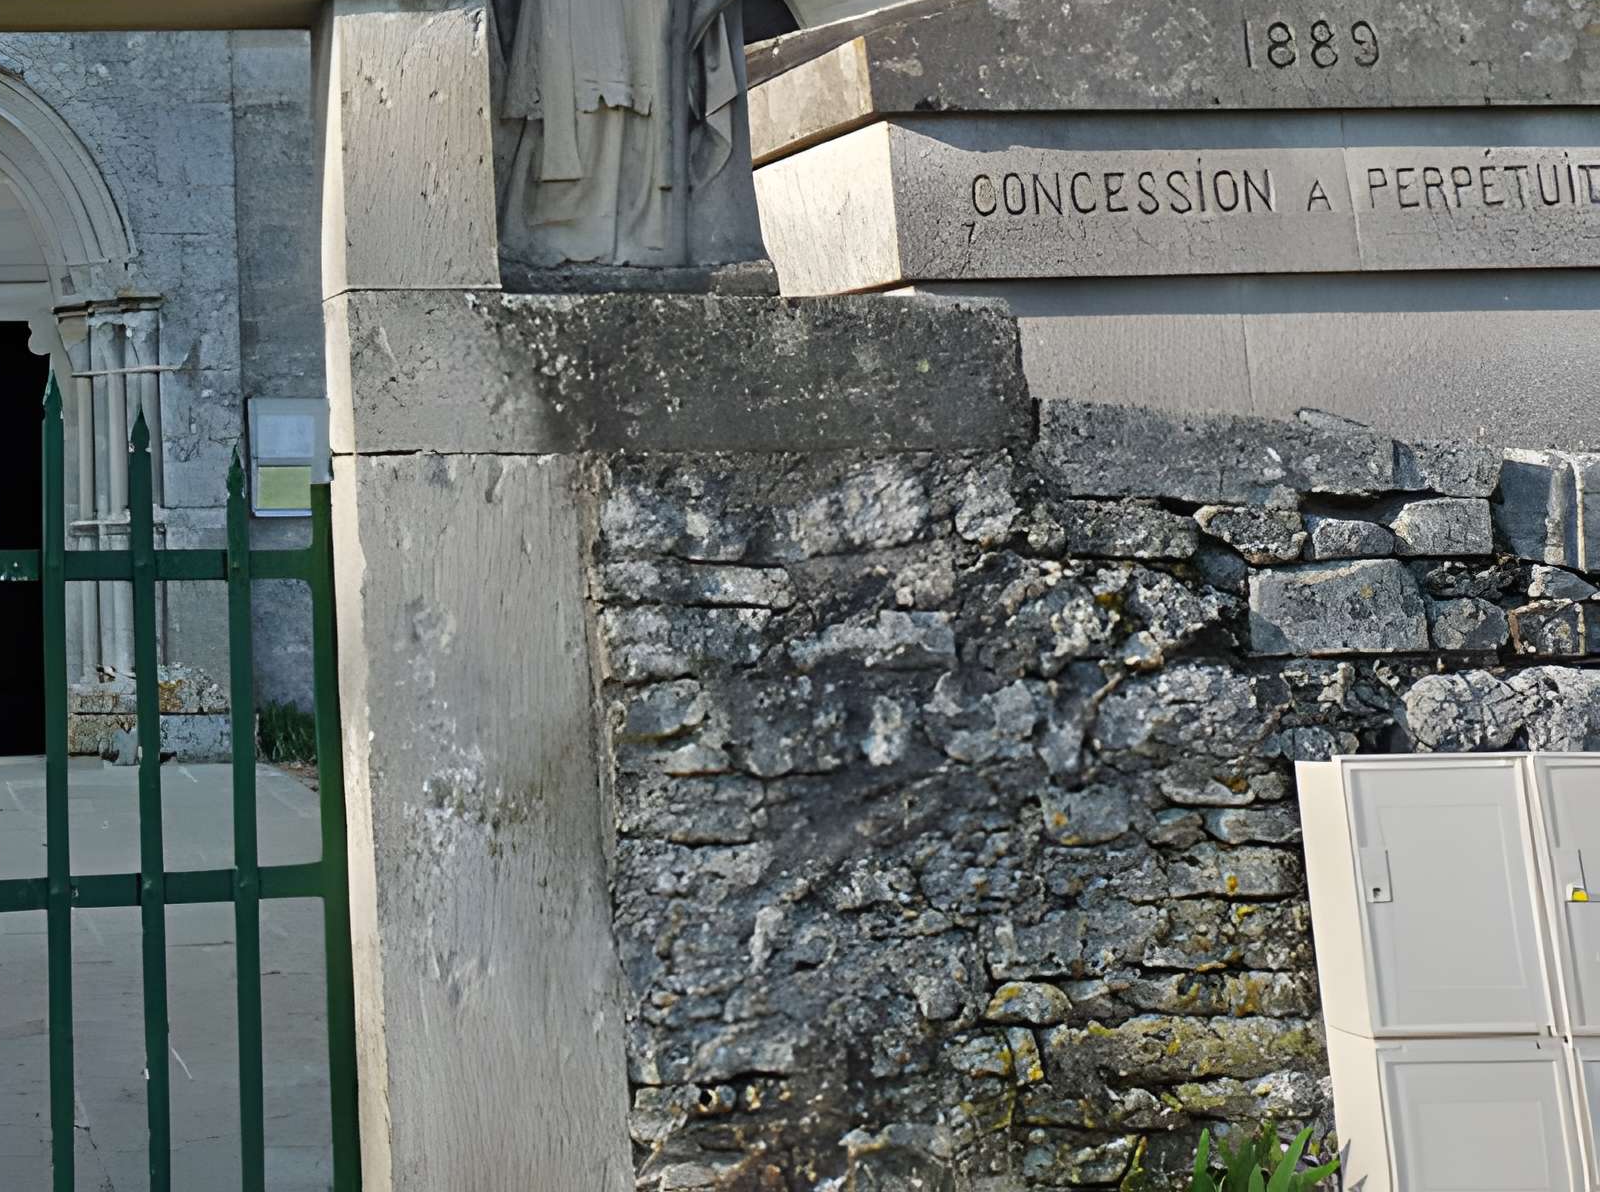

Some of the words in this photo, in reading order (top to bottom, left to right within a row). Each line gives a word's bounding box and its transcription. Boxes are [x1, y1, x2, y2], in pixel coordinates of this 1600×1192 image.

[1242, 18, 1380, 69] 1889
[971, 158, 1276, 216] CONCESSION
[1306, 179, 1333, 212] A
